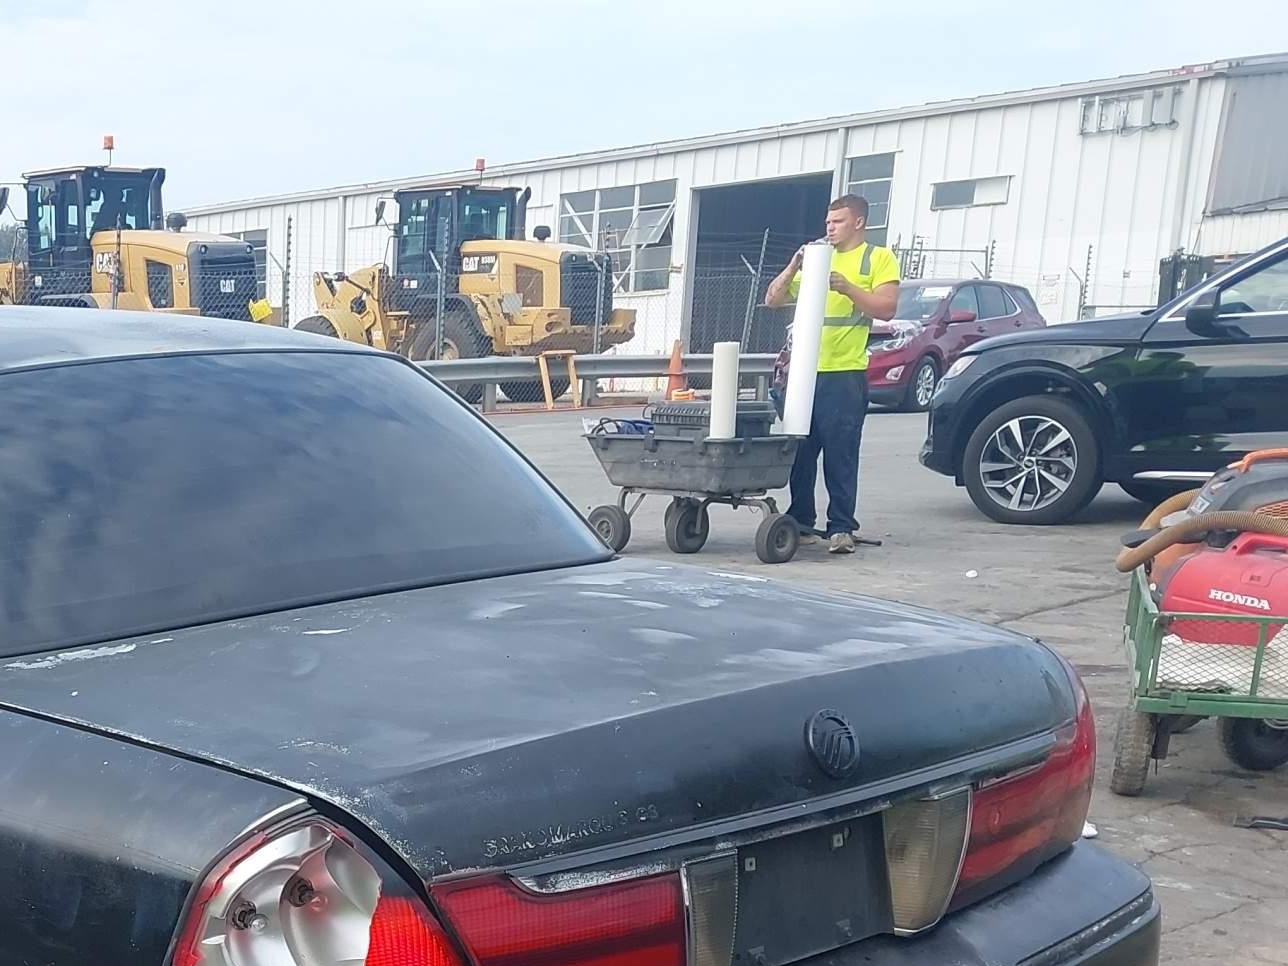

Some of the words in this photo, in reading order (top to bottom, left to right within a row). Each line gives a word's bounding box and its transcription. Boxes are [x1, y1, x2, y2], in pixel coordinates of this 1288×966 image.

[462, 256, 479, 272] CAT
[220, 279, 235, 293] CAT
[1208, 589, 1271, 611] HONDA
